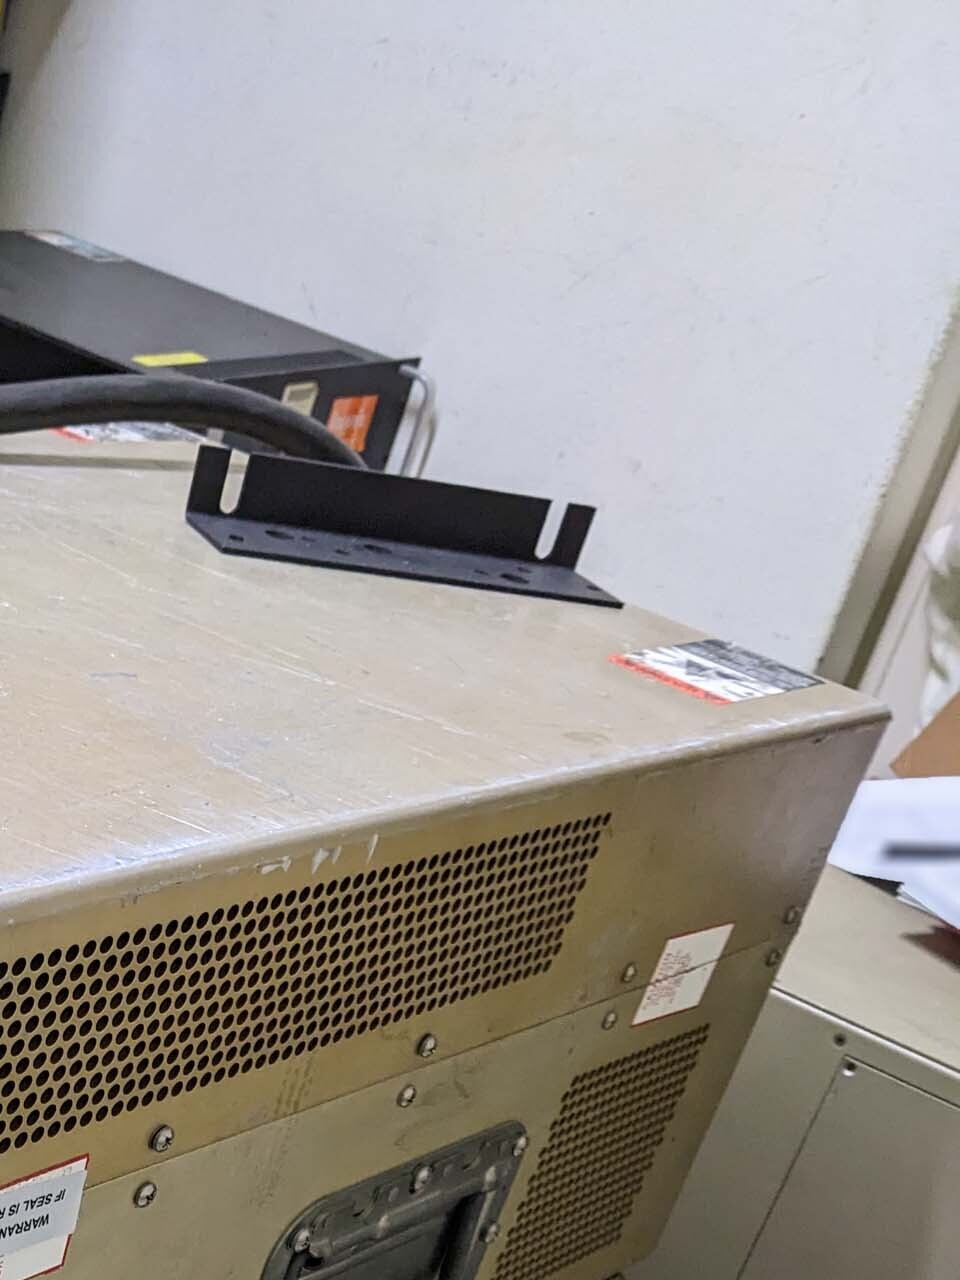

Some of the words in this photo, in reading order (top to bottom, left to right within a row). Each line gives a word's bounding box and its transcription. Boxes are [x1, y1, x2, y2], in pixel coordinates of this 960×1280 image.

[24, 1193, 53, 1211] SEAL
[54, 1188, 66, 1202] IF
[8, 1203, 20, 1217] IS
